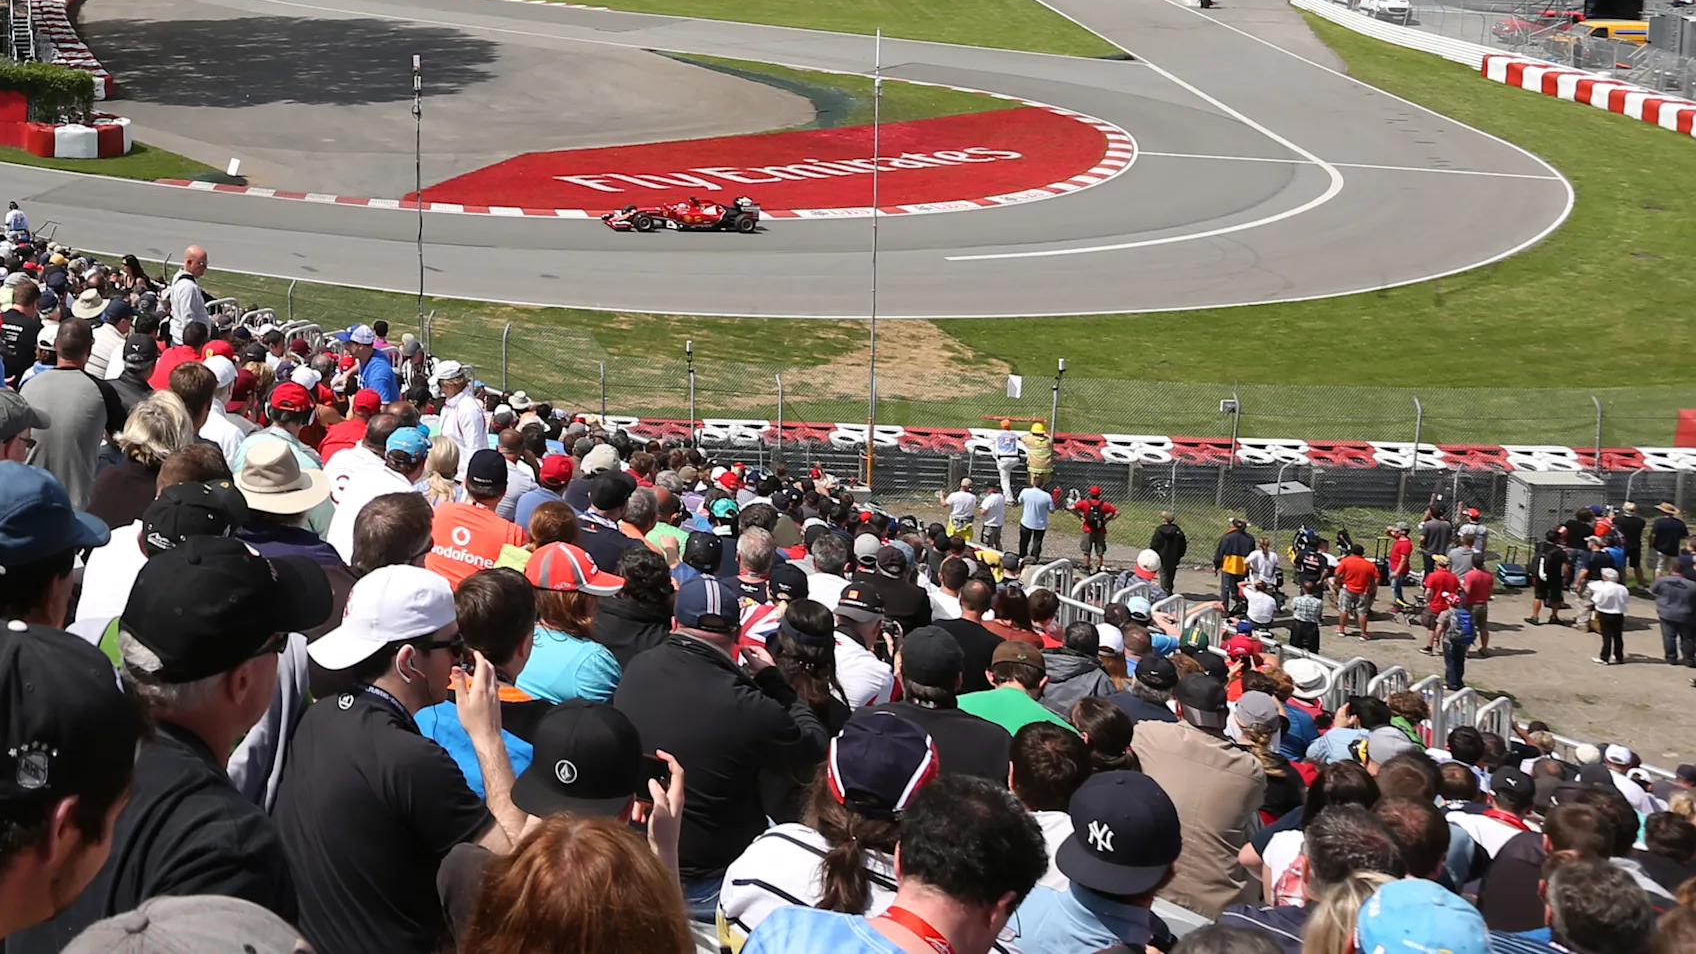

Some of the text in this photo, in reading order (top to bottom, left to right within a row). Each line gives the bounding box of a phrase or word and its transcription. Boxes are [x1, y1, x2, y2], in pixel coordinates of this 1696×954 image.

[552, 146, 1023, 193] Fly Emirates
[1087, 819, 1115, 852] NY
